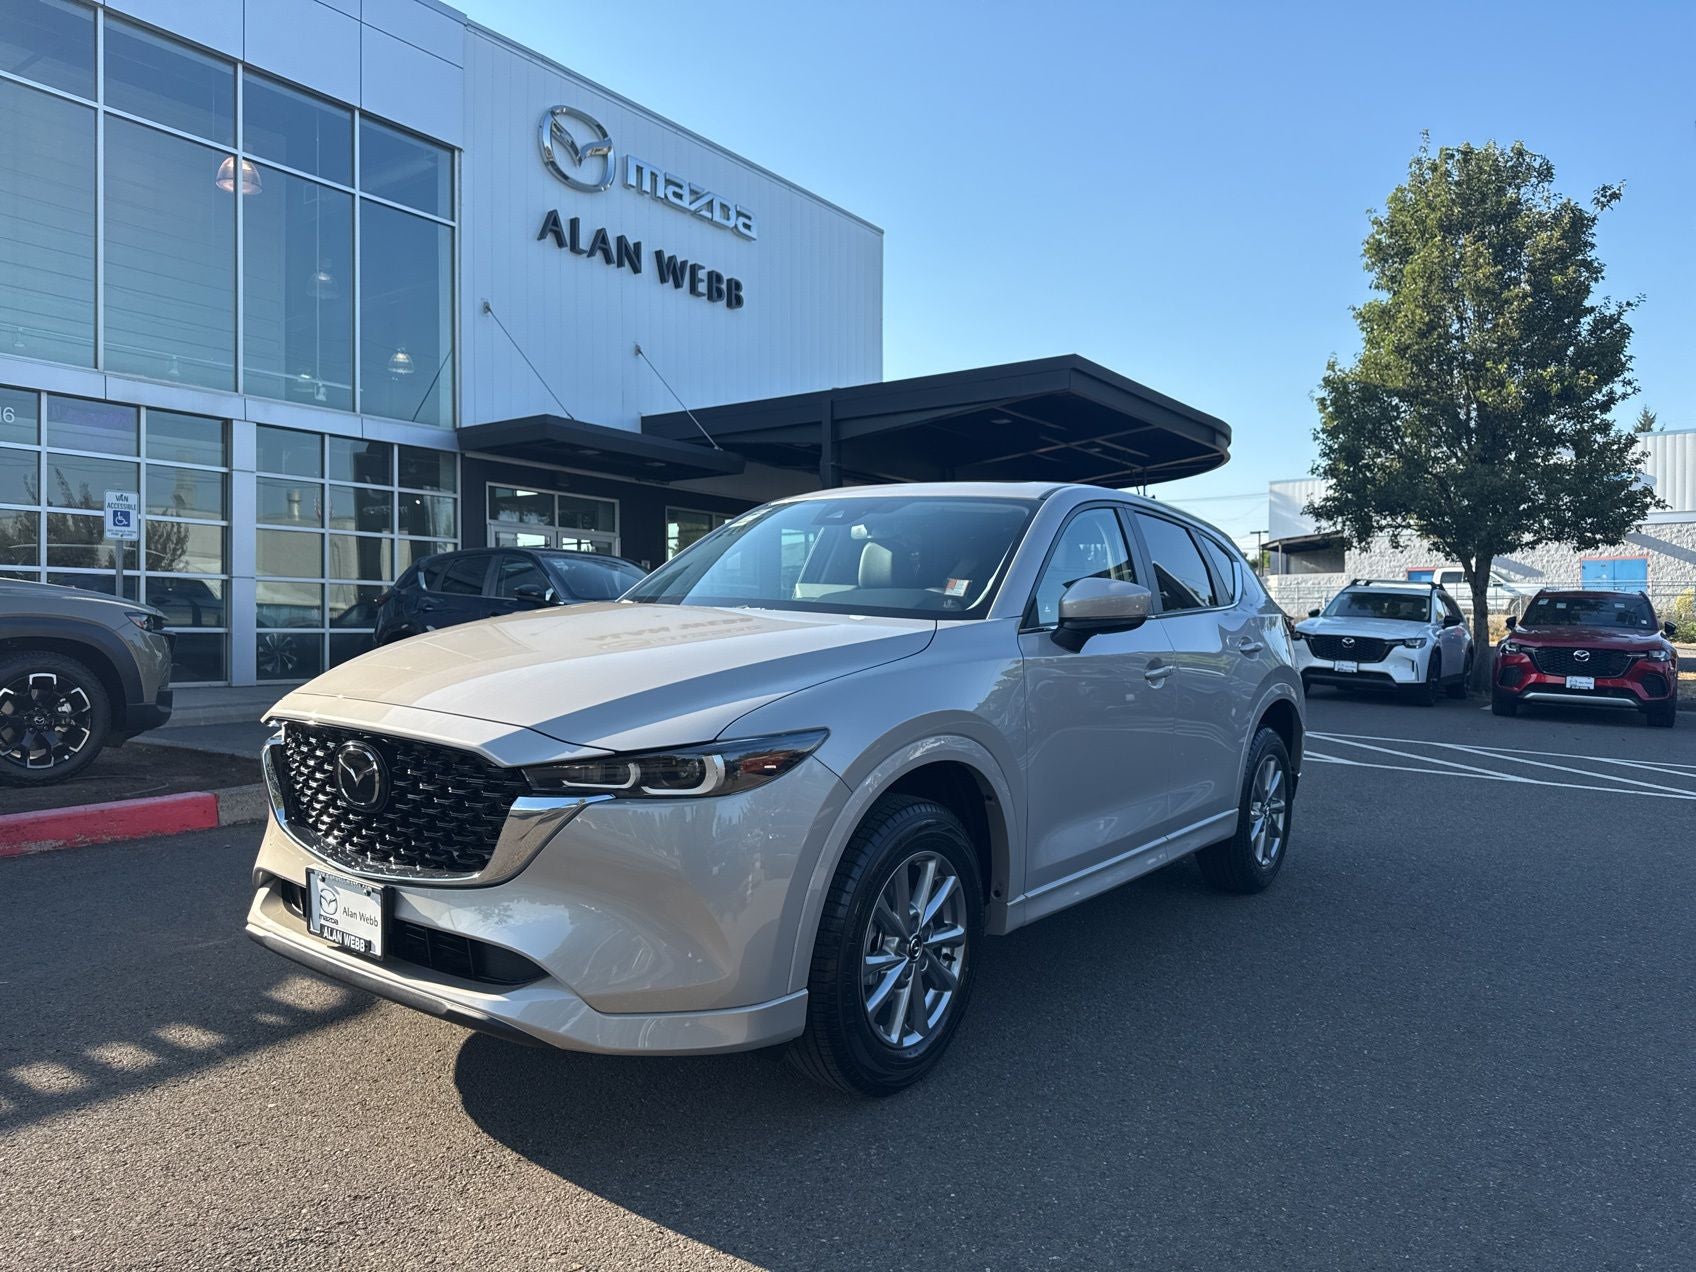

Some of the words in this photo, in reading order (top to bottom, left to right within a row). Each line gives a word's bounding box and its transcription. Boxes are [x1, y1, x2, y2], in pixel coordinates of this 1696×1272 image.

[623, 154, 757, 241] mazda
[537, 209, 642, 274] ALAN
[655, 249, 744, 309] WEBB
[323, 926, 342, 944] ALAN
[344, 932, 365, 952] WEBB
[343, 907, 357, 920] Alan
[359, 912, 378, 927] Webb
